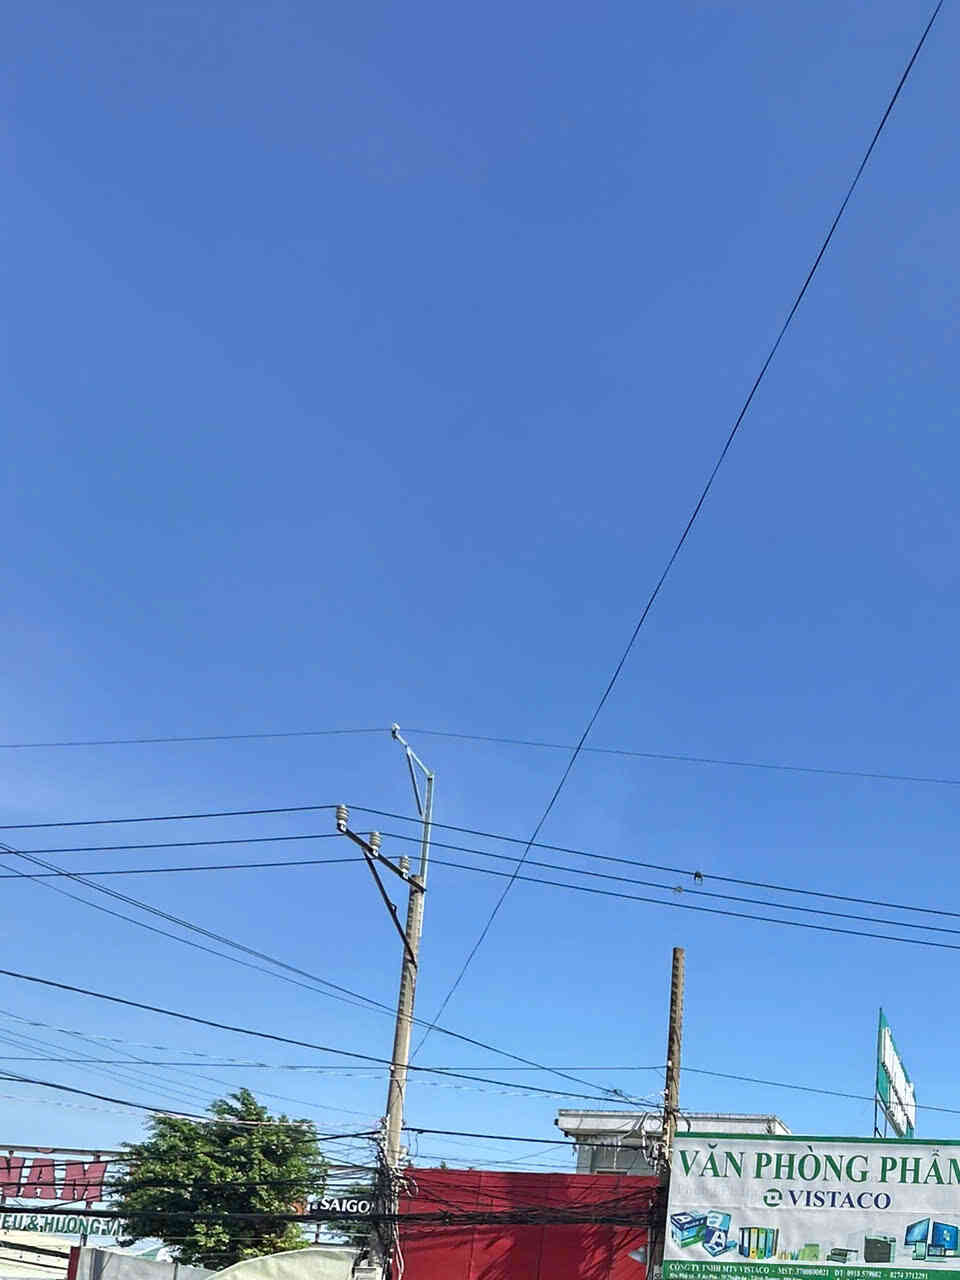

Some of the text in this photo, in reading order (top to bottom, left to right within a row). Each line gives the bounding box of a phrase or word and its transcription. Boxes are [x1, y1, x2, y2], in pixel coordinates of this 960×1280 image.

[679, 1143, 746, 1179] VĂN
[753, 1145, 870, 1184] PHÒNG
[788, 1190, 891, 1210] VISTACO
